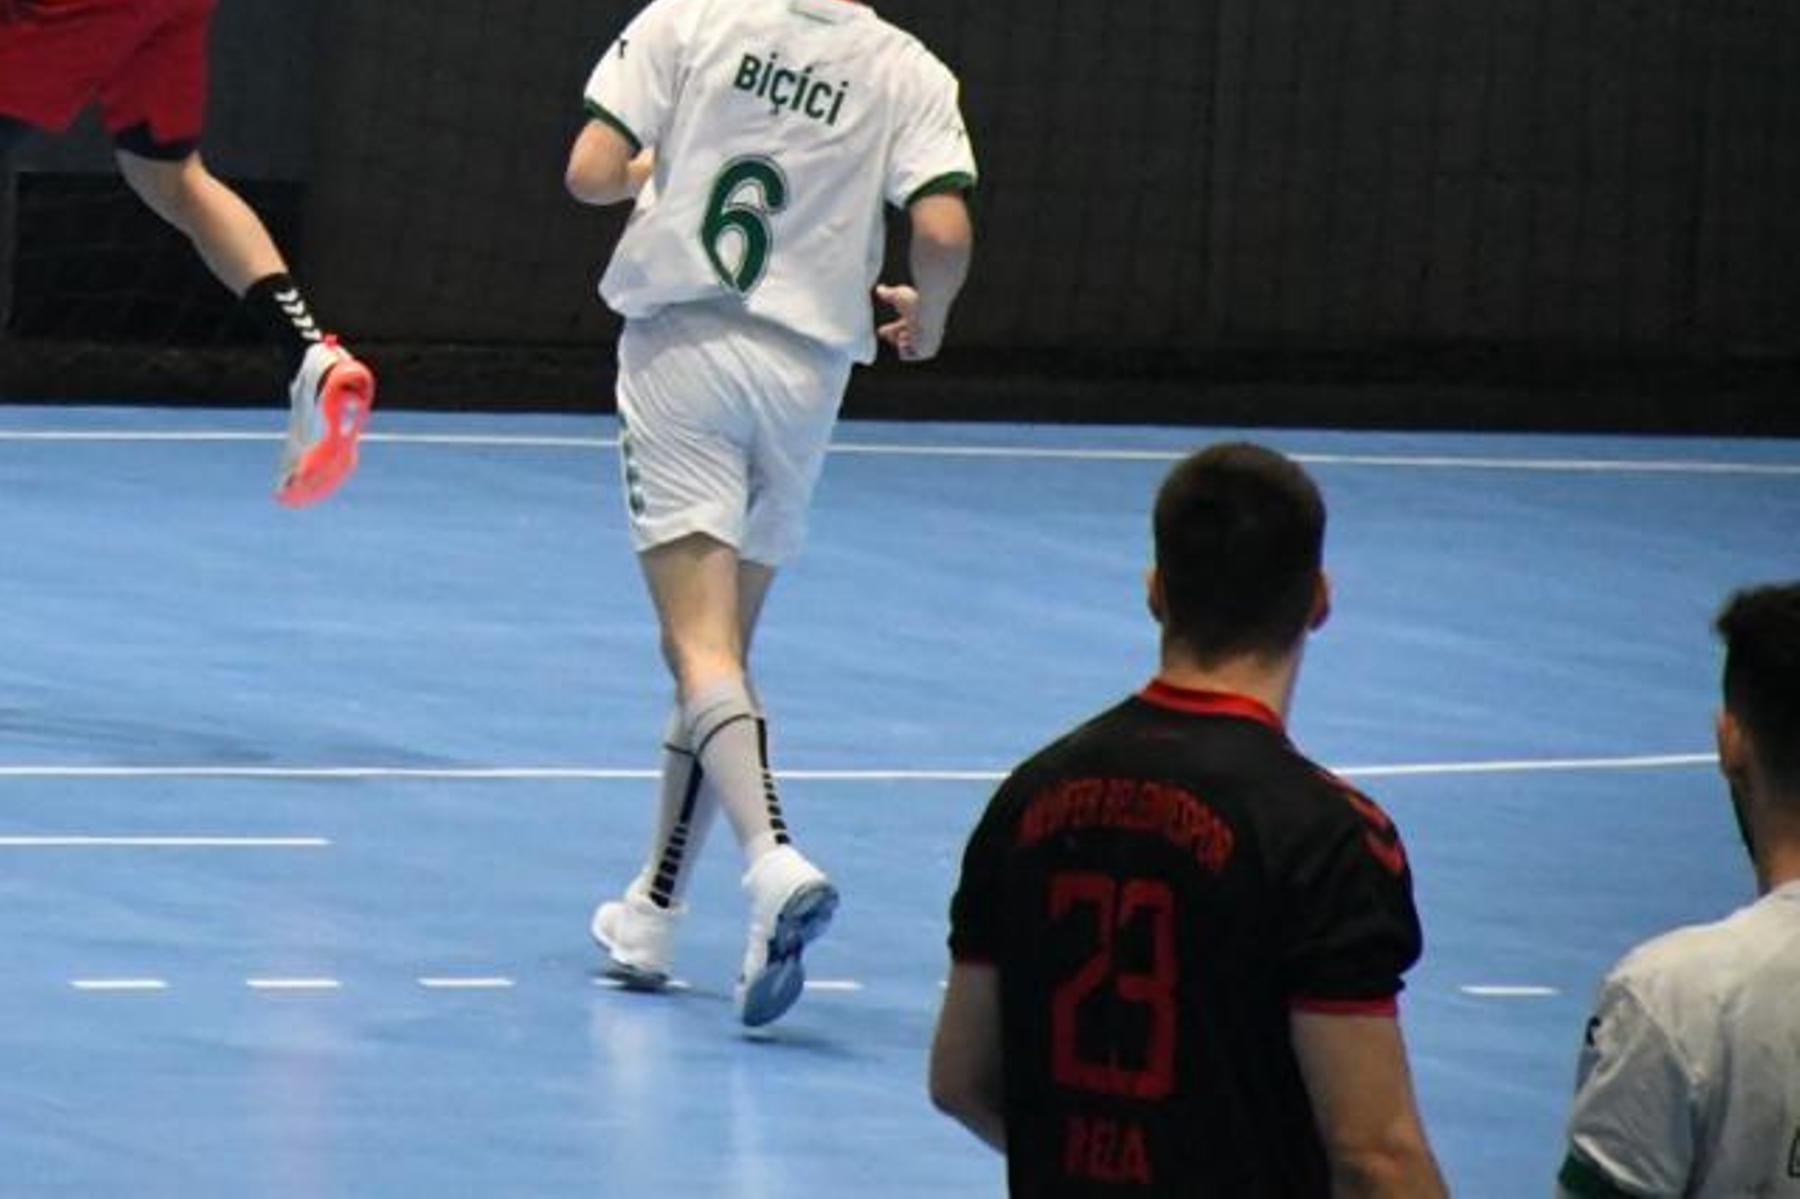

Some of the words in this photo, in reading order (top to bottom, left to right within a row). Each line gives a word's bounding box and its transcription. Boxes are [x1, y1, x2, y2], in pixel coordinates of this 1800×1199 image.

[733, 52, 849, 127] BİÇİCİ
[700, 153, 788, 297] 6
[1046, 870, 1180, 1103] 23
